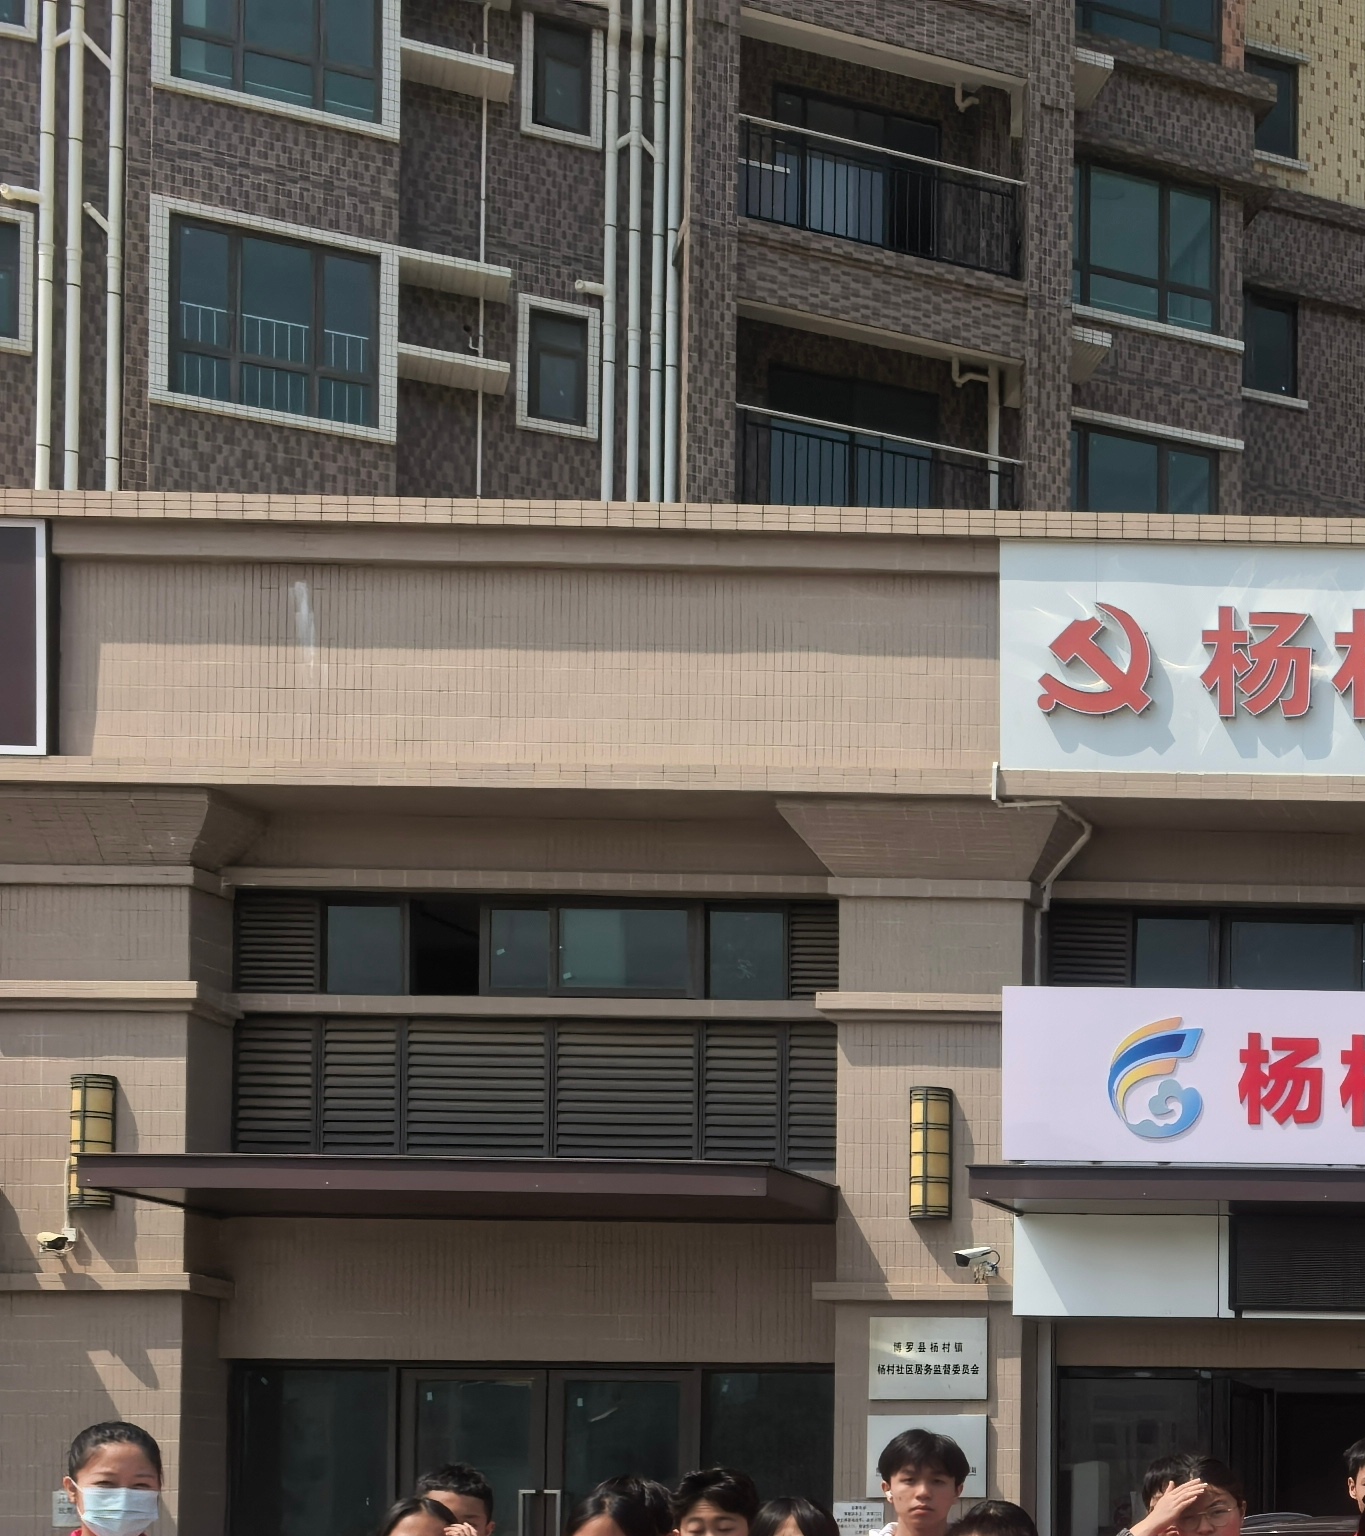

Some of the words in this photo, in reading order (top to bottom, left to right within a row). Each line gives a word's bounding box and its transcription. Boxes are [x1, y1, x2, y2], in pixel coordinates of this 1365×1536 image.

[893, 1341, 963, 1353] 博罗县杨村镇
[877, 1363, 980, 1375] 杨村社区居务监督委员会
